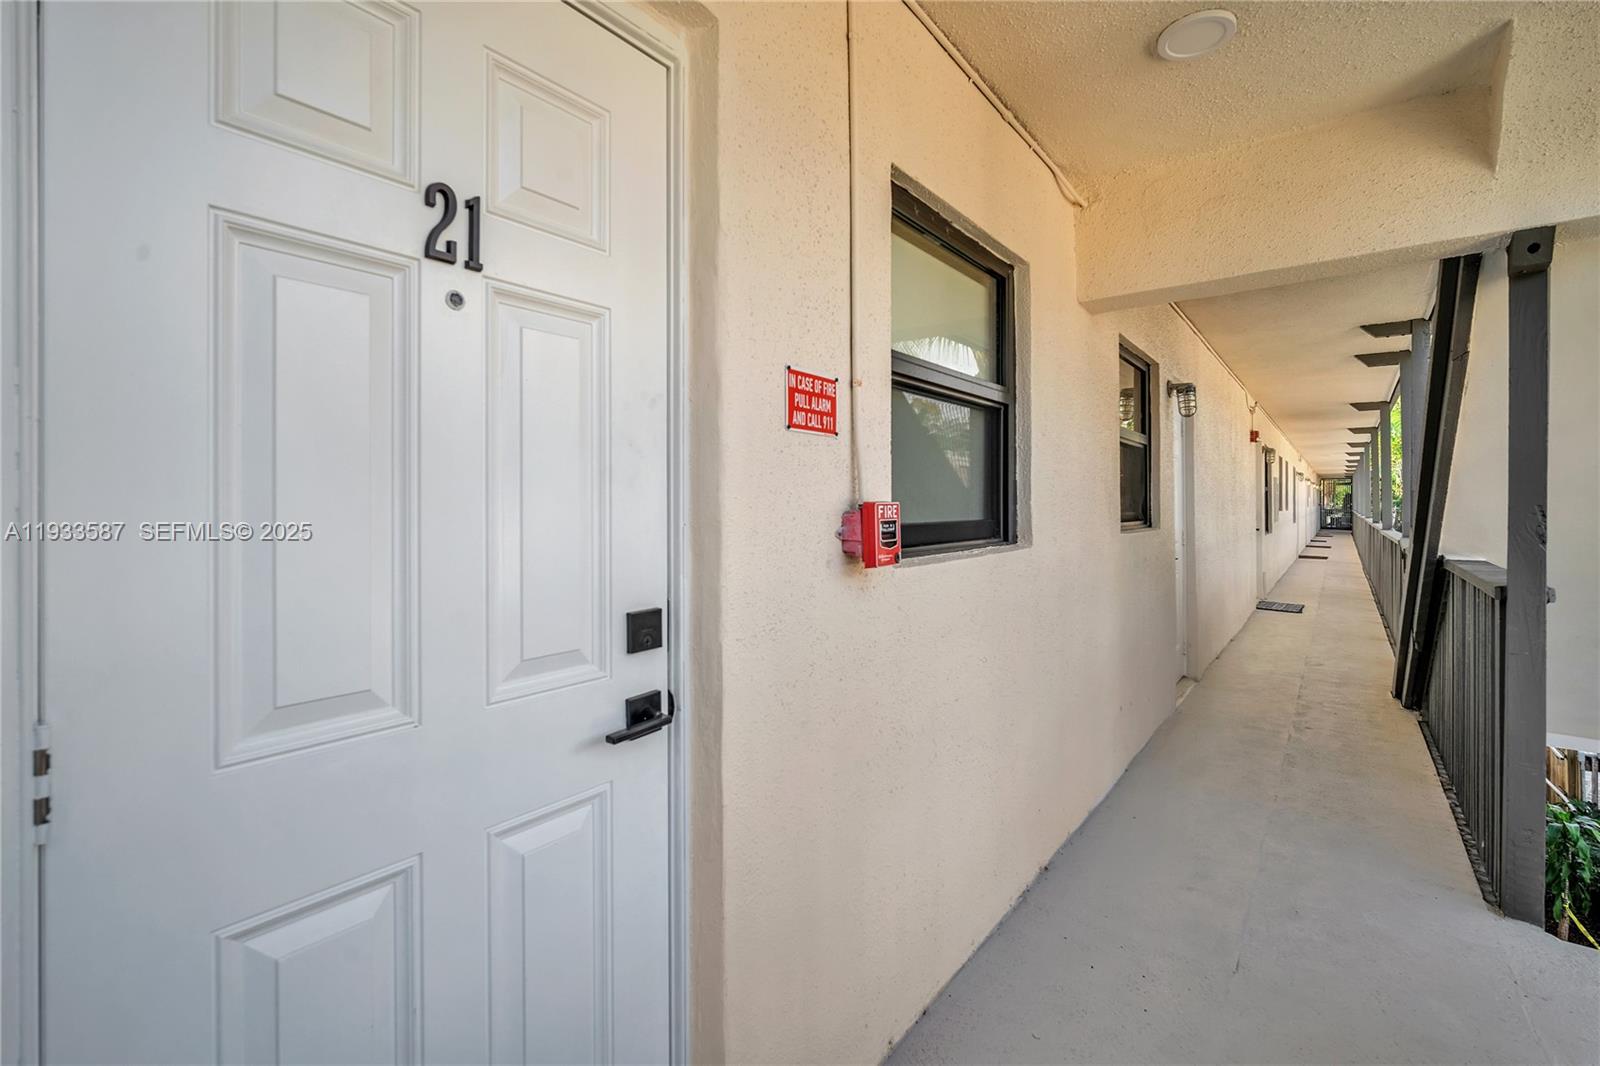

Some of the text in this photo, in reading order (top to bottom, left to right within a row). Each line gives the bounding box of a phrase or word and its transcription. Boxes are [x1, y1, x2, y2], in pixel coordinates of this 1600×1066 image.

[424, 182, 483, 273] 21
[788, 373, 836, 398] IN CASE OF FIRE
[794, 392, 832, 413] PULL ALARM
[792, 410, 833, 431] AND CALL 911
[878, 505, 898, 518] FIRE
